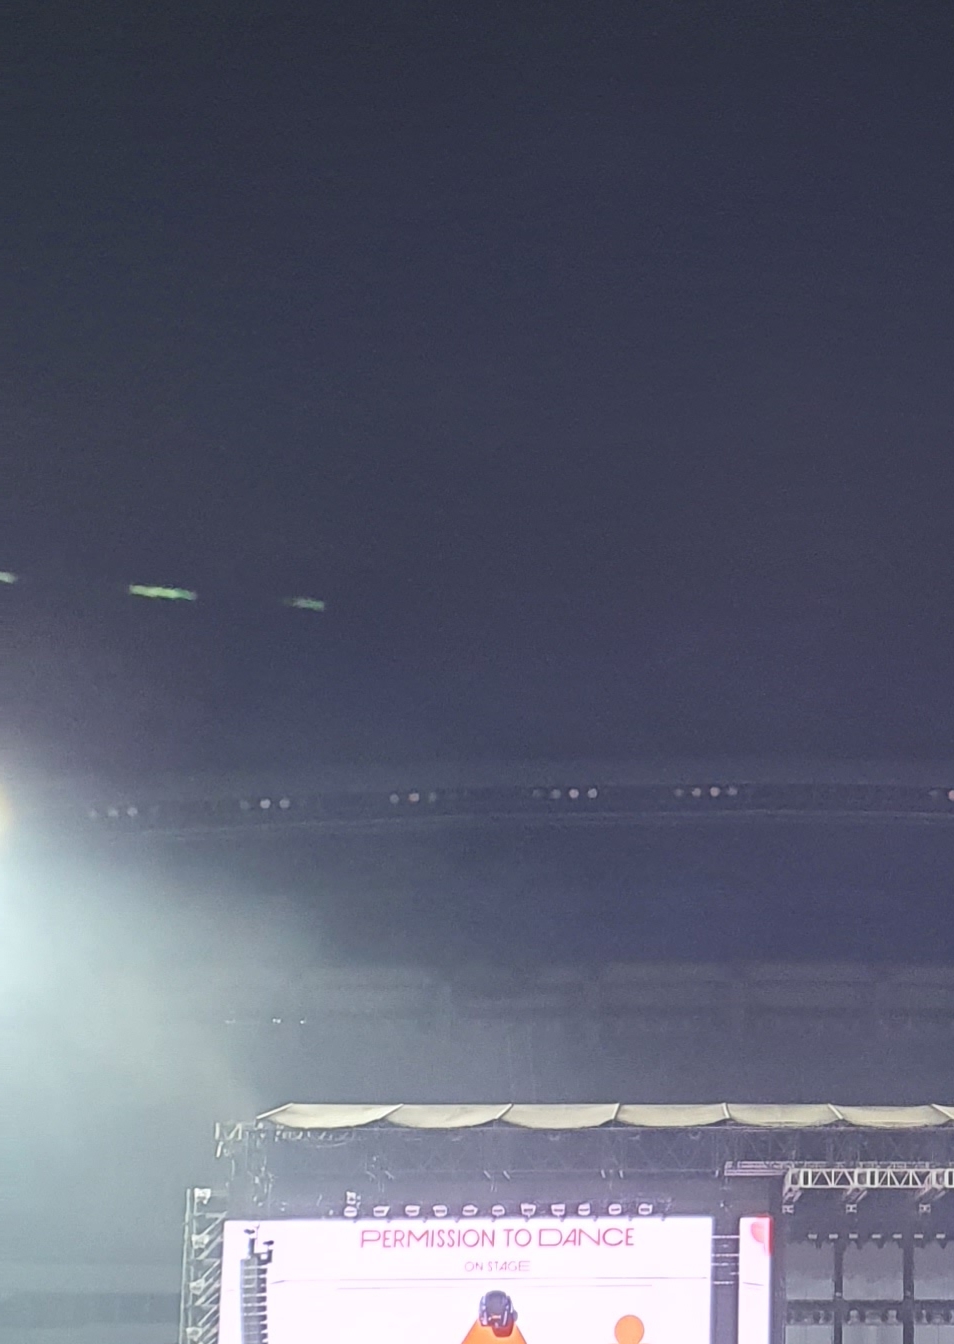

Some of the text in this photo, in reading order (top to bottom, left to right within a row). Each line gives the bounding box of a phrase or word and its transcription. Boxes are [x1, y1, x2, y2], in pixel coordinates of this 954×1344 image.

[360, 1228, 634, 1248] PERMISSION TO DANCE
[464, 1260, 530, 1272] ON STAGE
